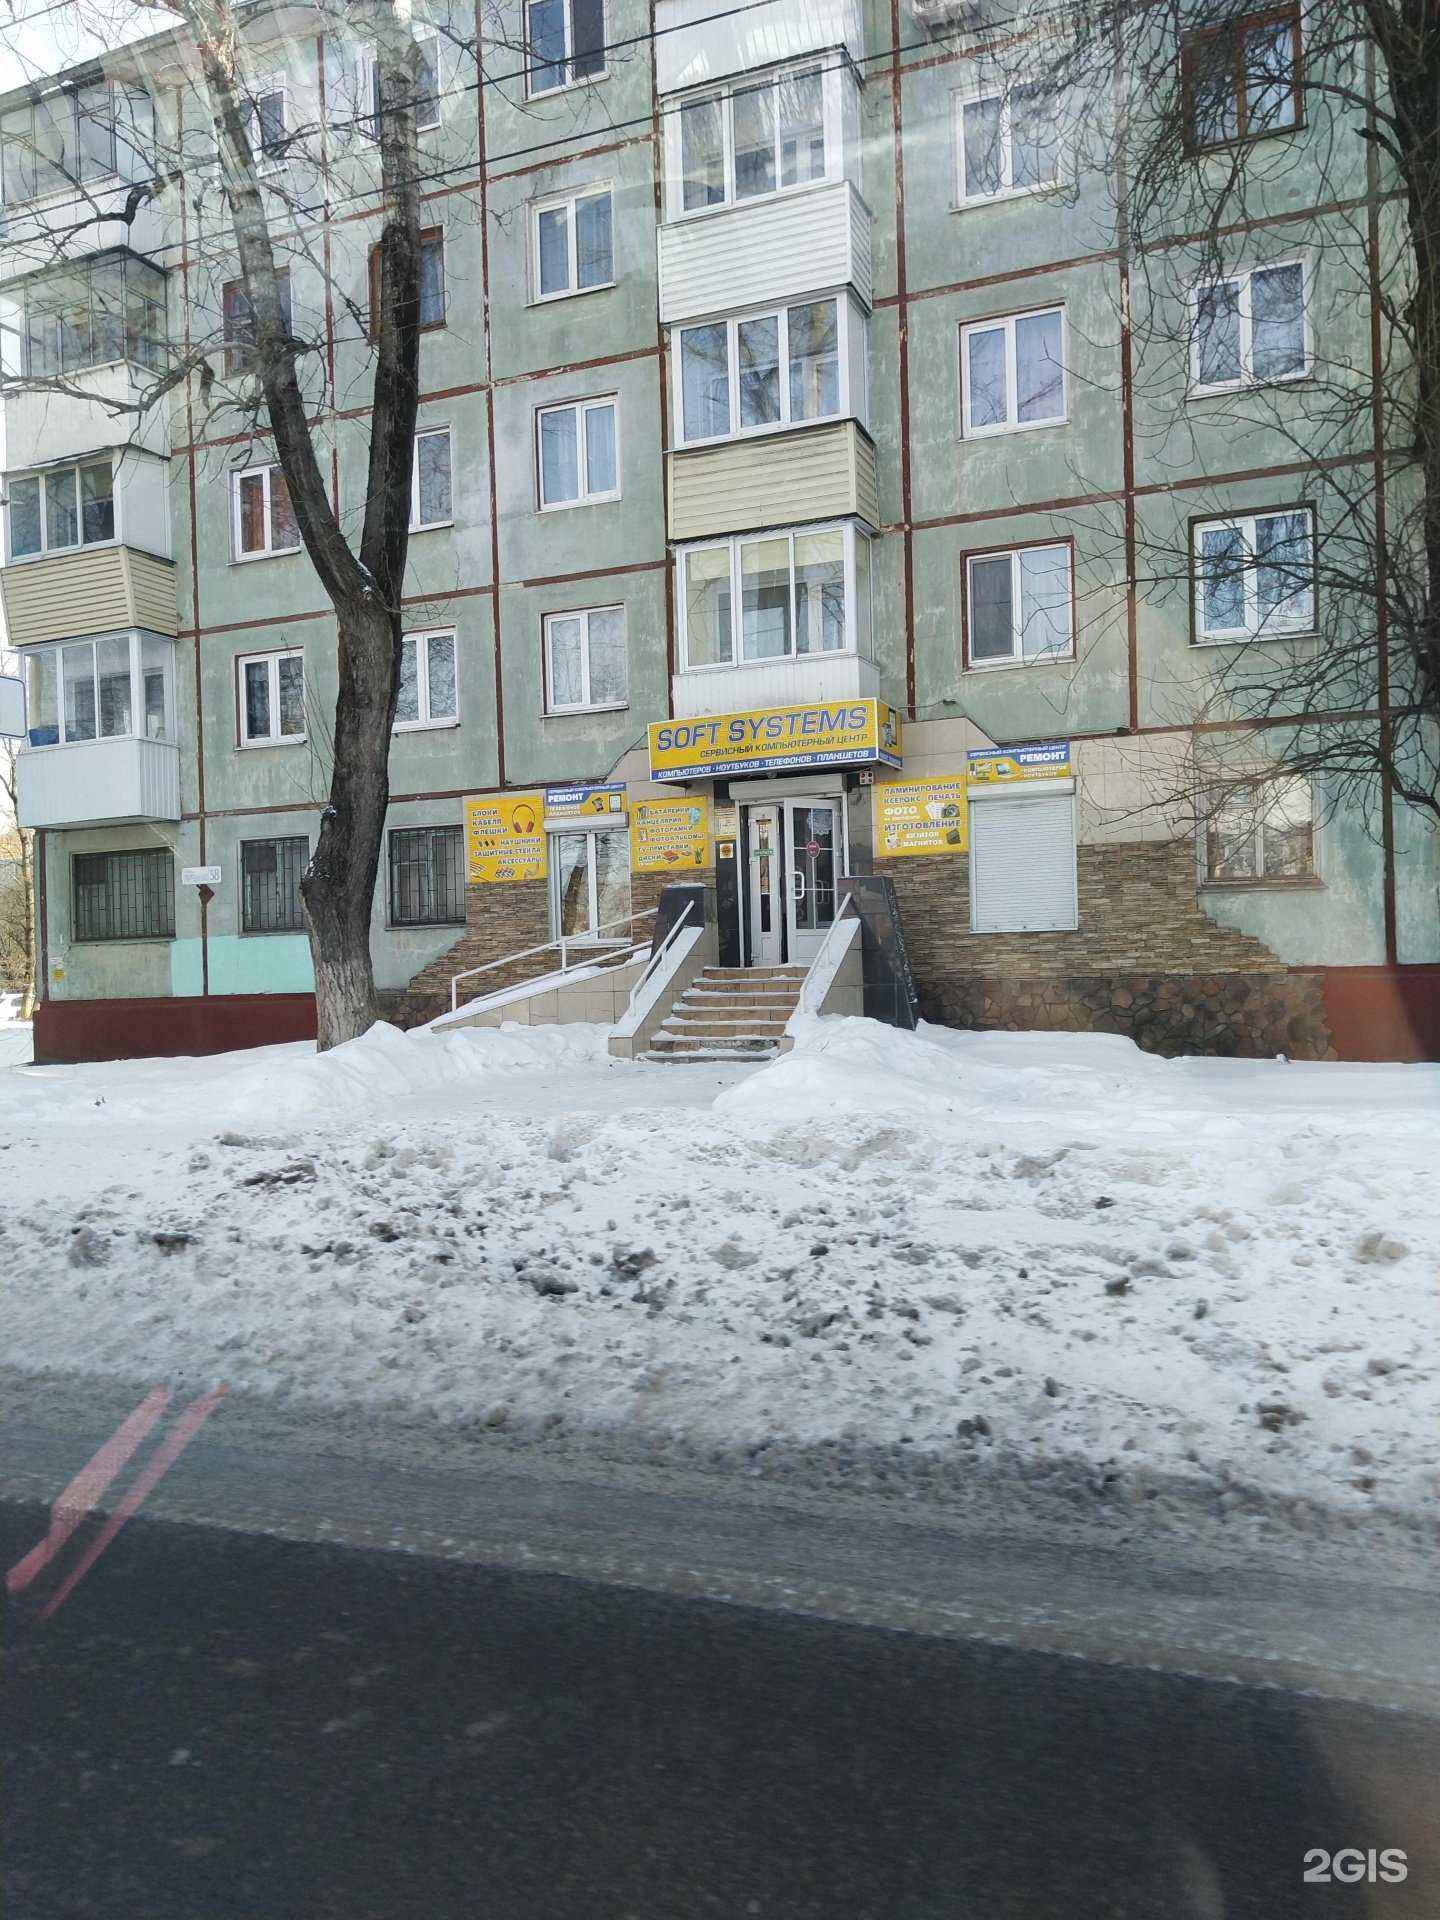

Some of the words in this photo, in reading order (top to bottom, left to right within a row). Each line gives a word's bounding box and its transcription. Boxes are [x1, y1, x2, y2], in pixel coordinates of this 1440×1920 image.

[657, 721, 722, 752] SOFT
[728, 704, 868, 743] SYSTEMS
[700, 743, 753, 758] СЕРВИСНЫЙ
[755, 736, 834, 751] КОМПЬЮТЕРНЫЙ
[837, 732, 868, 744] ЦЕНТР
[1020, 751, 1067, 763] РЕМОНТ
[658, 765, 712, 778] КОМПЬЮТЕРОВ
[715, 760, 760, 772] НОУТБУКОВ
[765, 755, 812, 767] ТЕЛЕФОНОВ
[816, 749, 870, 761] ПЛАНШЕТОВ
[884, 783, 960, 795] ЛАМИНИРОВАНИЕ
[548, 793, 584, 803] РЕМОНТ
[884, 796, 921, 804] КСЕРОКС
[928, 793, 961, 801] ПЕЧАТЬ
[472, 809, 498, 817] БЛОКИ
[883, 806, 918, 816] ФОТО
[473, 827, 508, 835] ФЛЕШКИ
[884, 820, 961, 832] ИЗГОТОВЛЕНИЕ
[500, 837, 541, 845] НАУШНИКИ
[474, 849, 513, 857] ЗАЩИТНЫЕ
